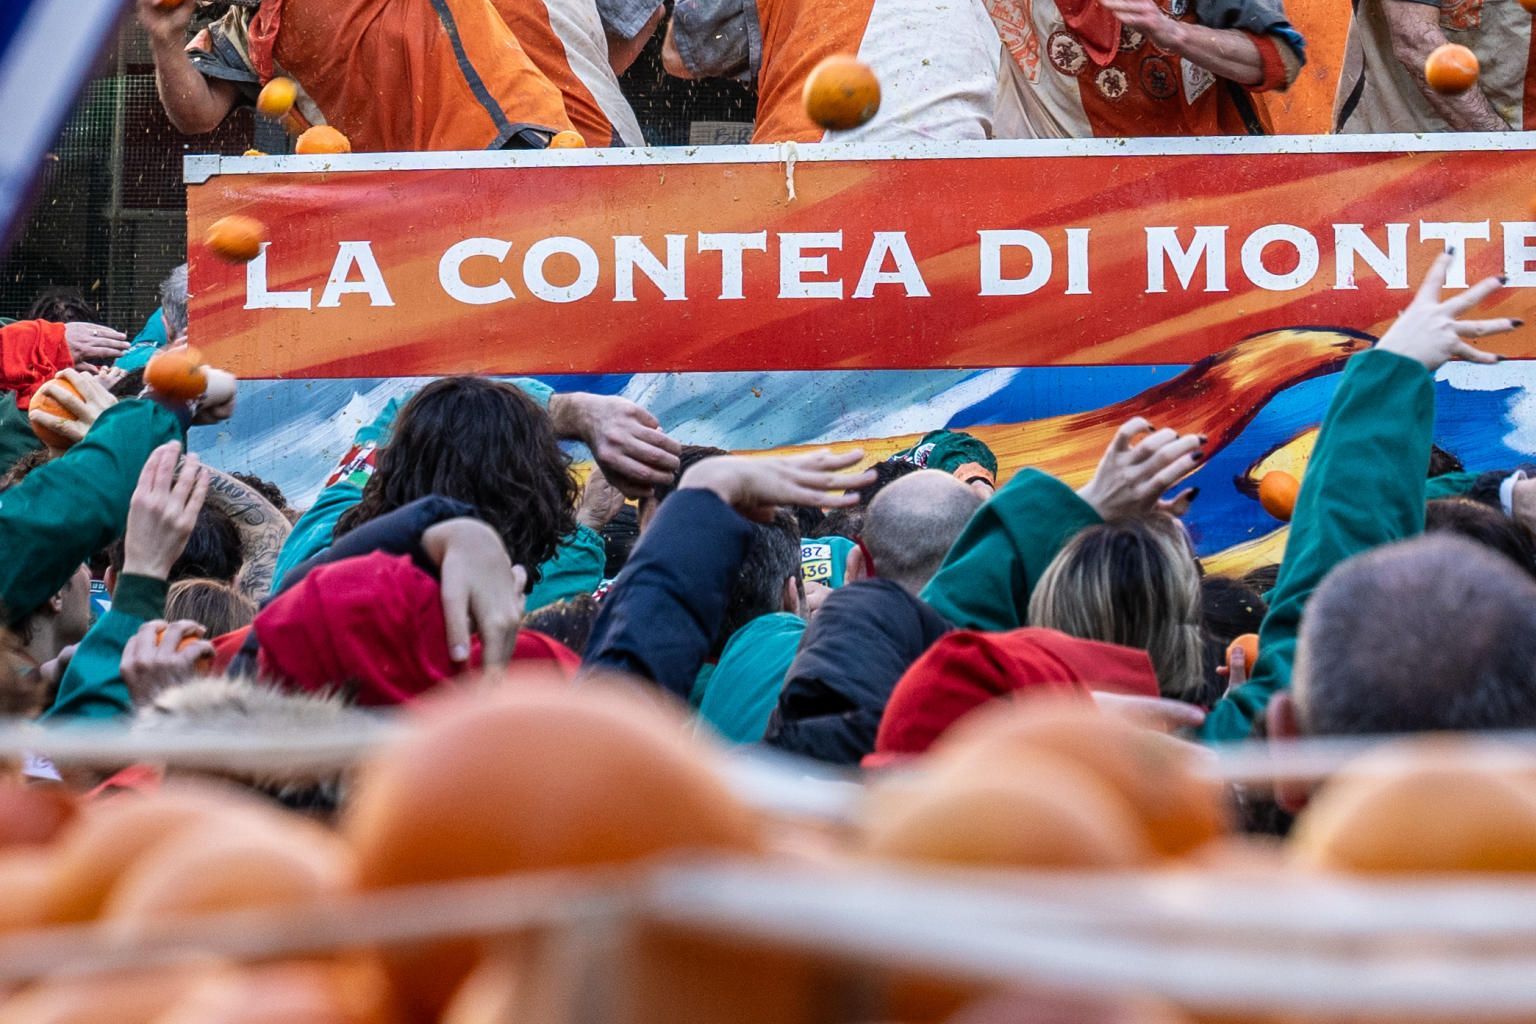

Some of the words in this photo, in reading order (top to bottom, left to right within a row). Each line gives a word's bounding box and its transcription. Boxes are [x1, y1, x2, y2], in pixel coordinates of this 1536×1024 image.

[242, 240, 396, 311] LA
[437, 228, 932, 305] CONTEA
[976, 227, 1092, 296] DI
